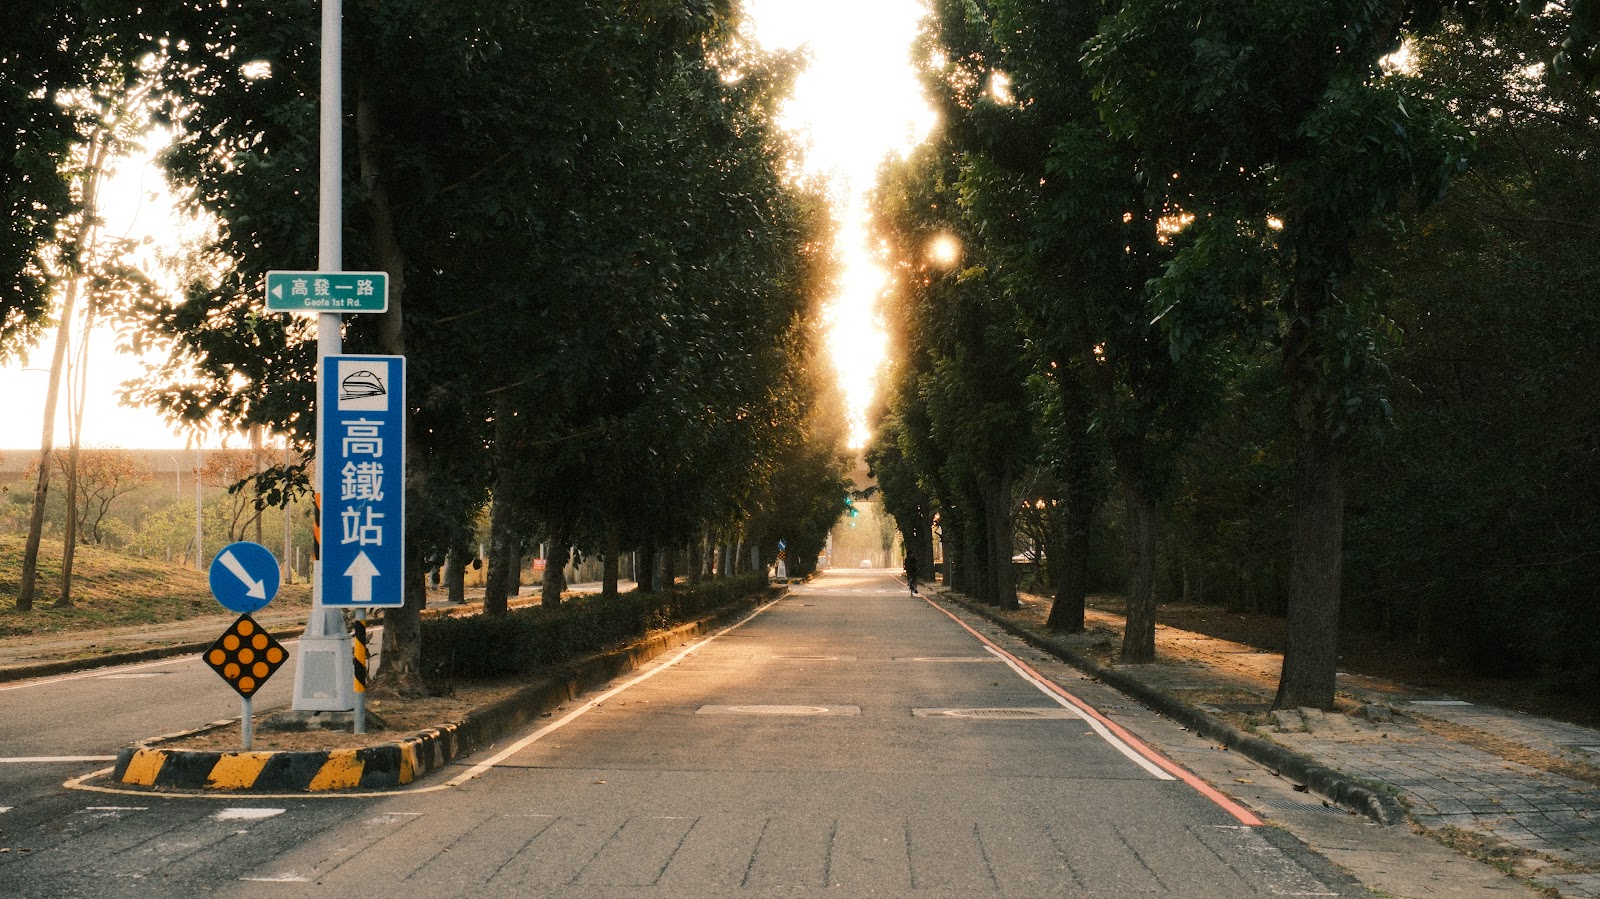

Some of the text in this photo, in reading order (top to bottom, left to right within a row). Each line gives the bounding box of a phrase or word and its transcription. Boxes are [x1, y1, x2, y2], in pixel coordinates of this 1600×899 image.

[291, 278, 374, 296] 高發一路
[304, 298, 330, 306] Gaofa
[347, 298, 361, 306] Rd.
[341, 417, 384, 546] 高鐵站
